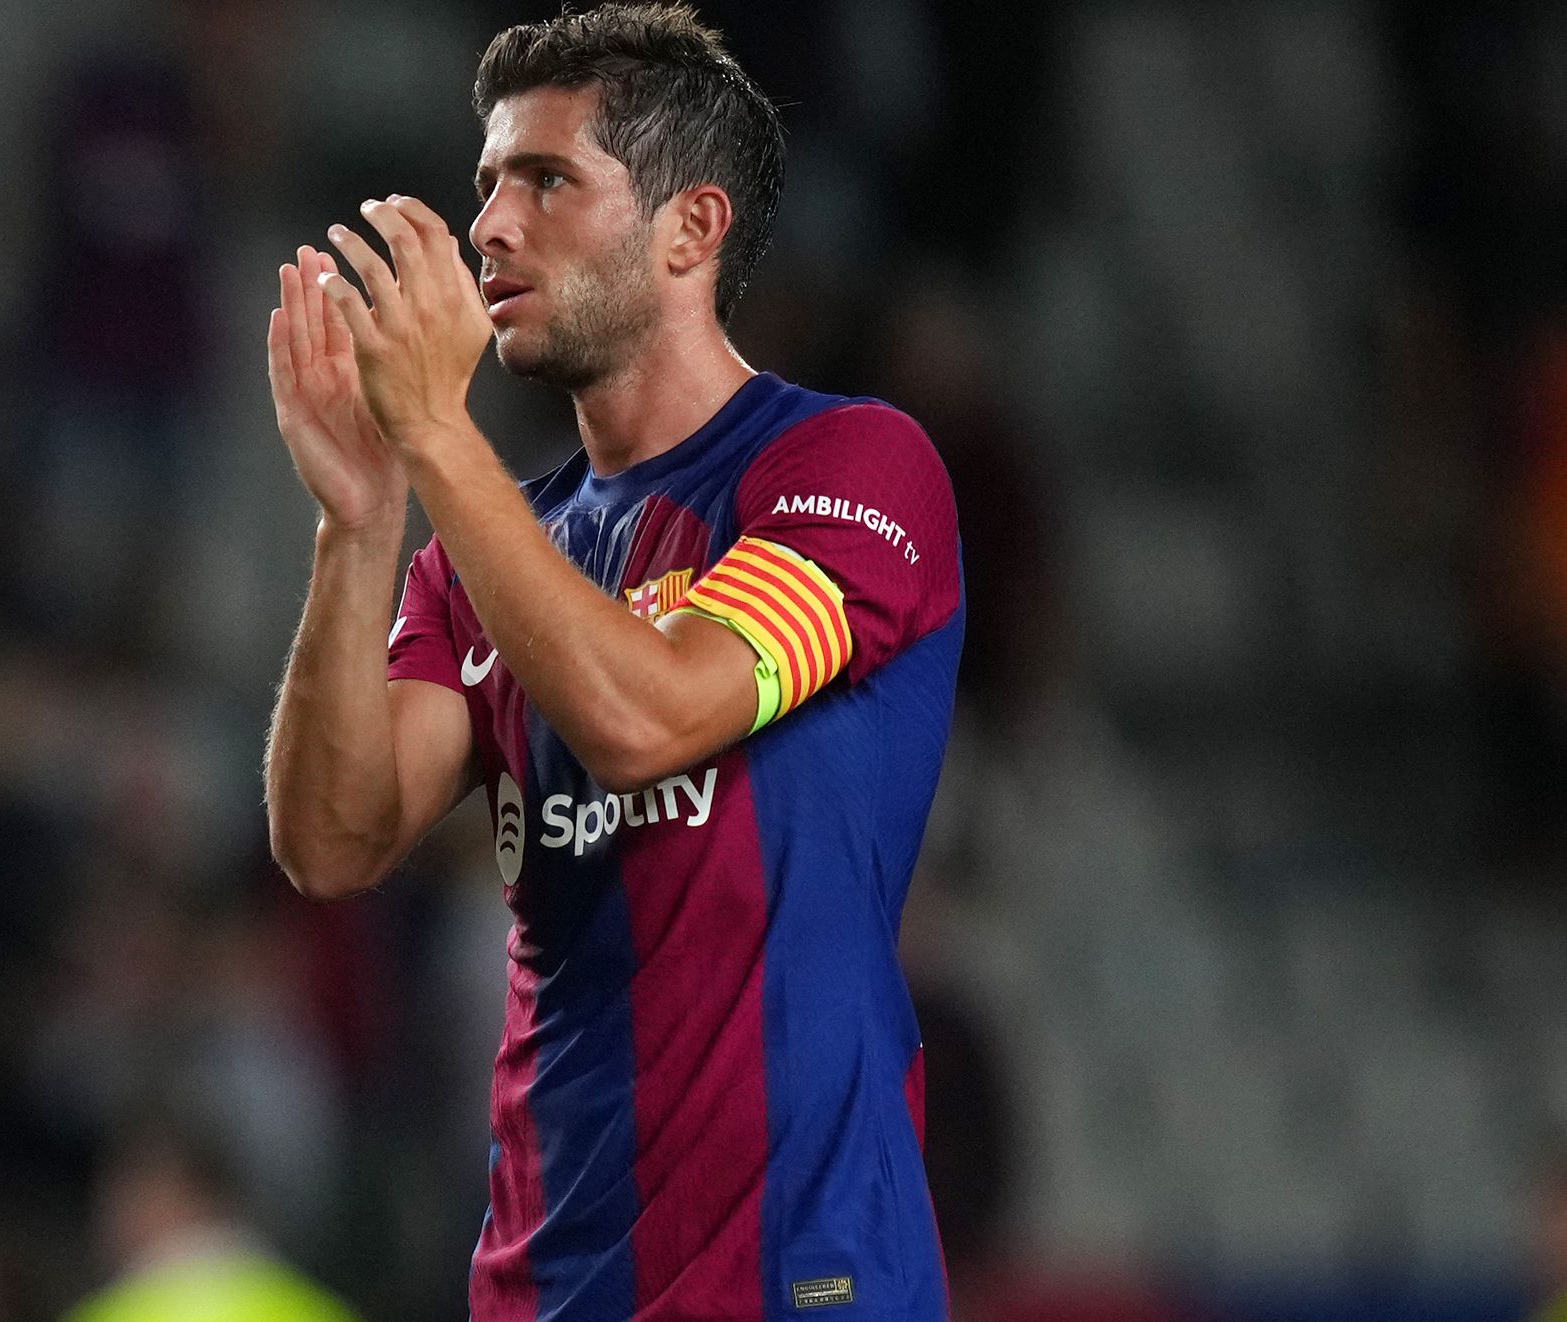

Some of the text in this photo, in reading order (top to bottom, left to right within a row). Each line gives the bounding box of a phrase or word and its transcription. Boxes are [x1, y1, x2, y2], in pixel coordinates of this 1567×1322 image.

[772, 495, 920, 564] AMBILIGHT tv
[539, 768, 718, 857] Spotify
